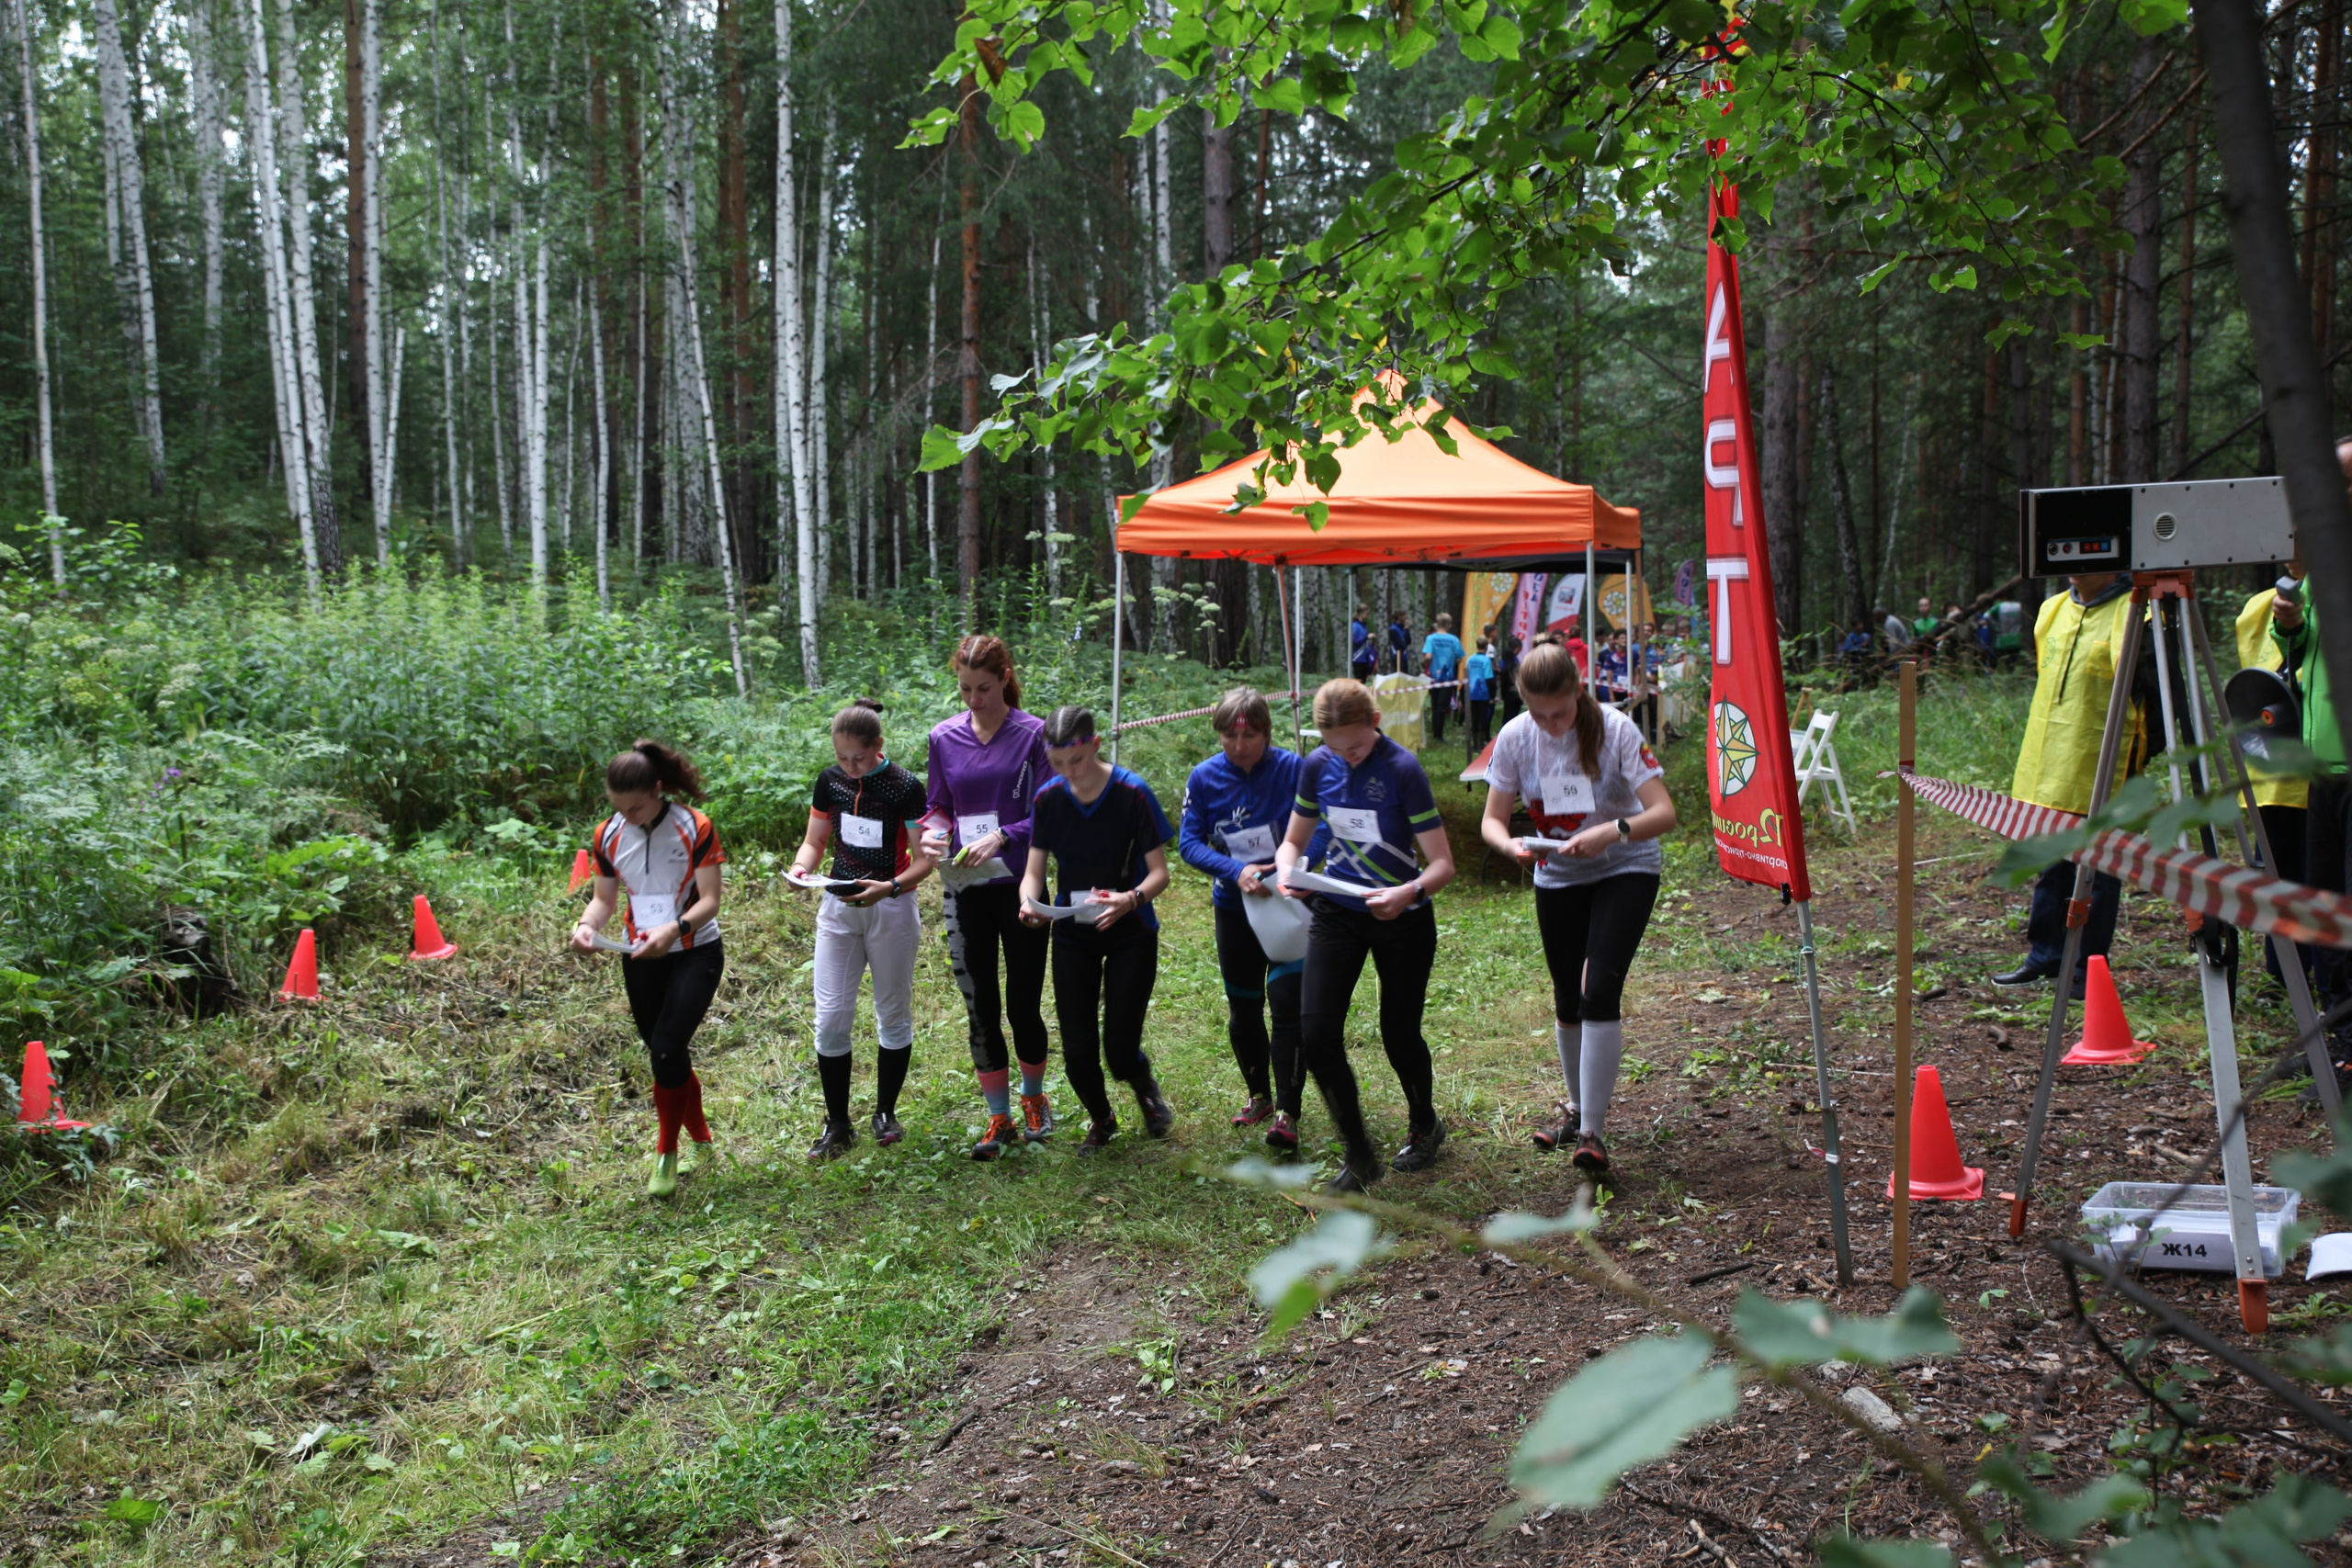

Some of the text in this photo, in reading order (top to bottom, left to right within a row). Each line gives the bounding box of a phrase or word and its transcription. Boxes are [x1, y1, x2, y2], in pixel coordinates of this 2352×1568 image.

[858, 826, 870, 835] 54
[976, 824, 988, 833] 55
[1248, 836, 1261, 848] 57
[2162, 1243, 2207, 1257] Ж14
